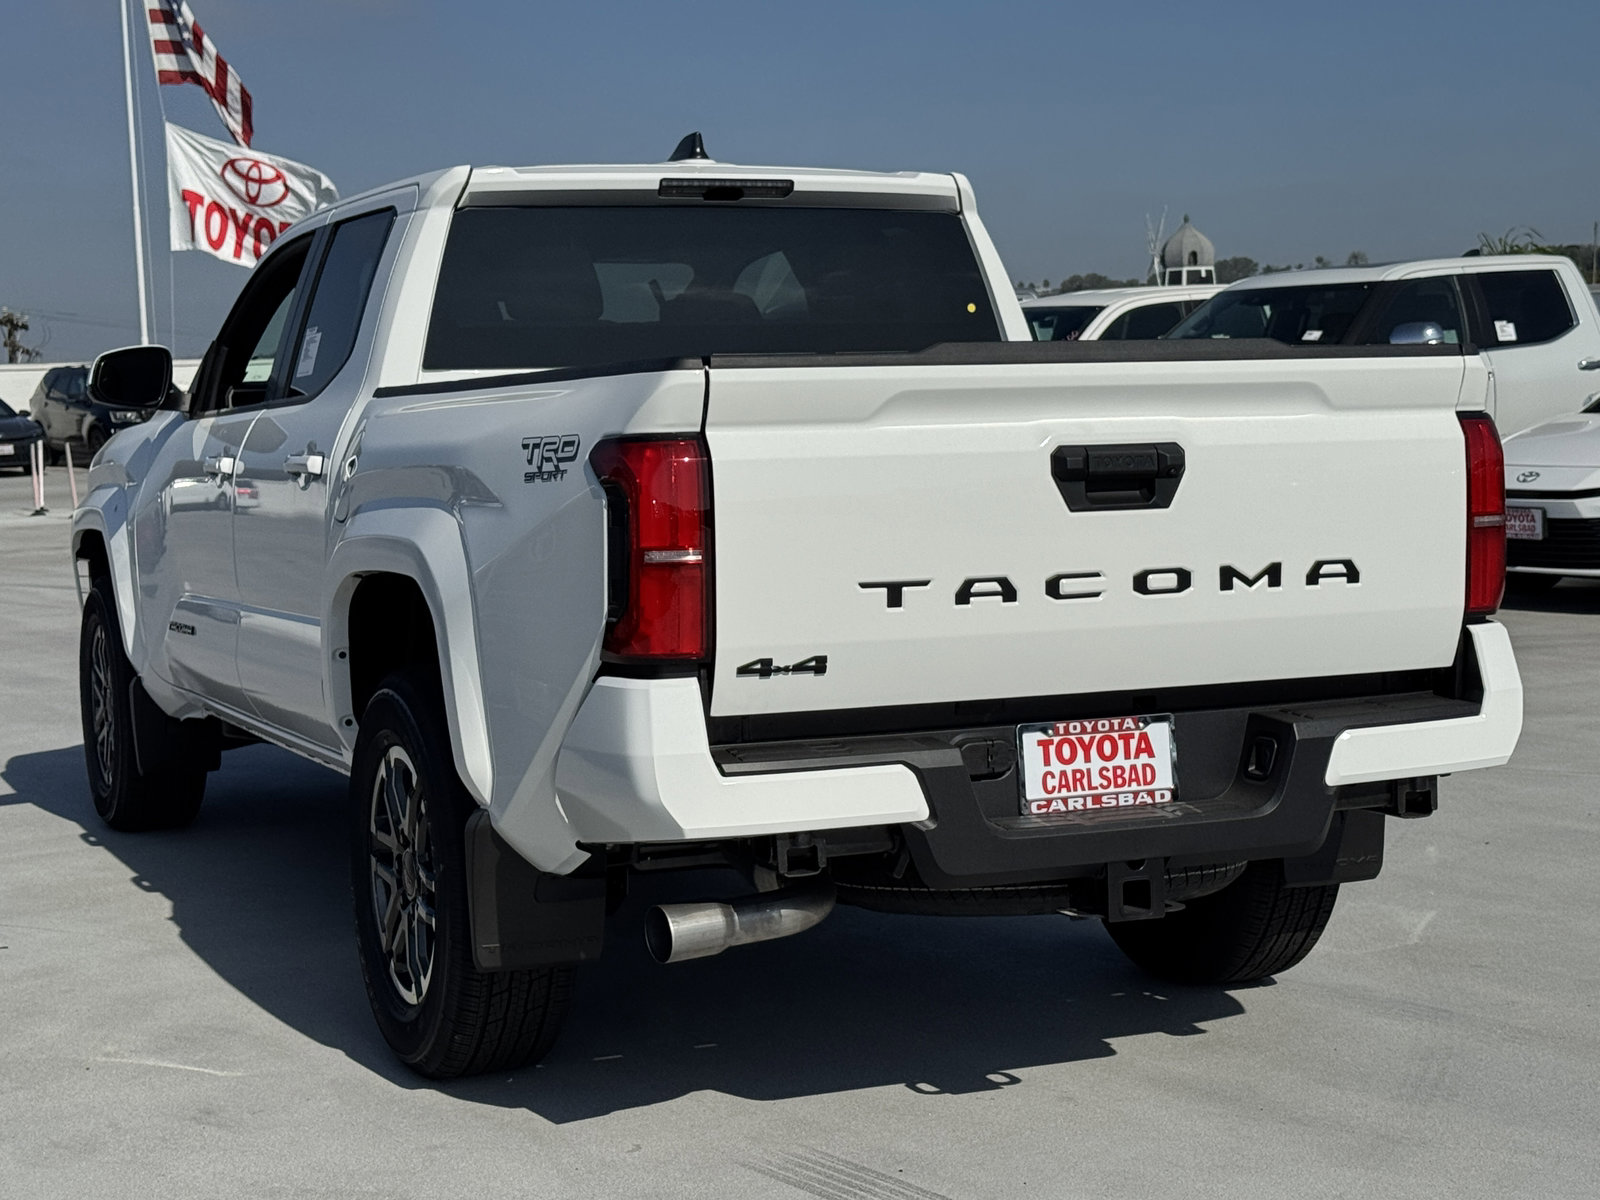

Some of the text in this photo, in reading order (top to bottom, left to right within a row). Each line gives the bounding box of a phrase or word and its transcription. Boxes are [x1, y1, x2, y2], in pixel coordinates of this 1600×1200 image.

[181, 189, 293, 261] TOYO
[521, 434, 581, 473] TRD
[524, 469, 568, 483] SPORT
[1505, 513, 1536, 523] OYOTA
[857, 558, 1361, 609] TACOMA
[1056, 717, 1136, 735] TOYOTA
[1036, 731, 1156, 767] TOYOTA
[1041, 763, 1157, 795] CARLSBAD
[1030, 789, 1172, 814] CARLSBAD
